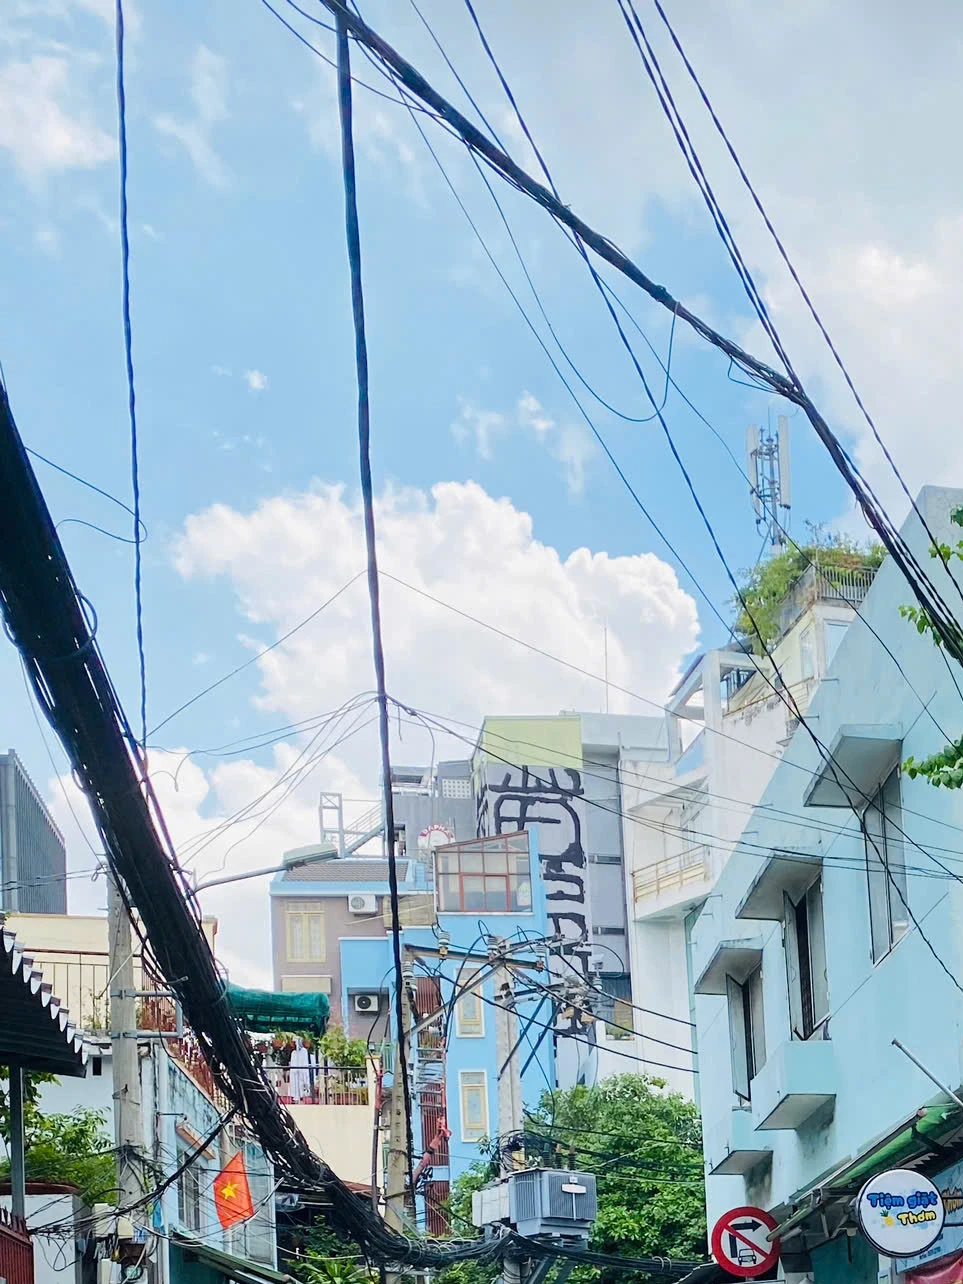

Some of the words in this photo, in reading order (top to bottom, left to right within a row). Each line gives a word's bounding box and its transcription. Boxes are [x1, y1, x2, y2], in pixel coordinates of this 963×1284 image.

[867, 1192, 905, 1210] Tiệm
[907, 1191, 938, 1209] giặt
[897, 1210, 937, 1226] Thơm
